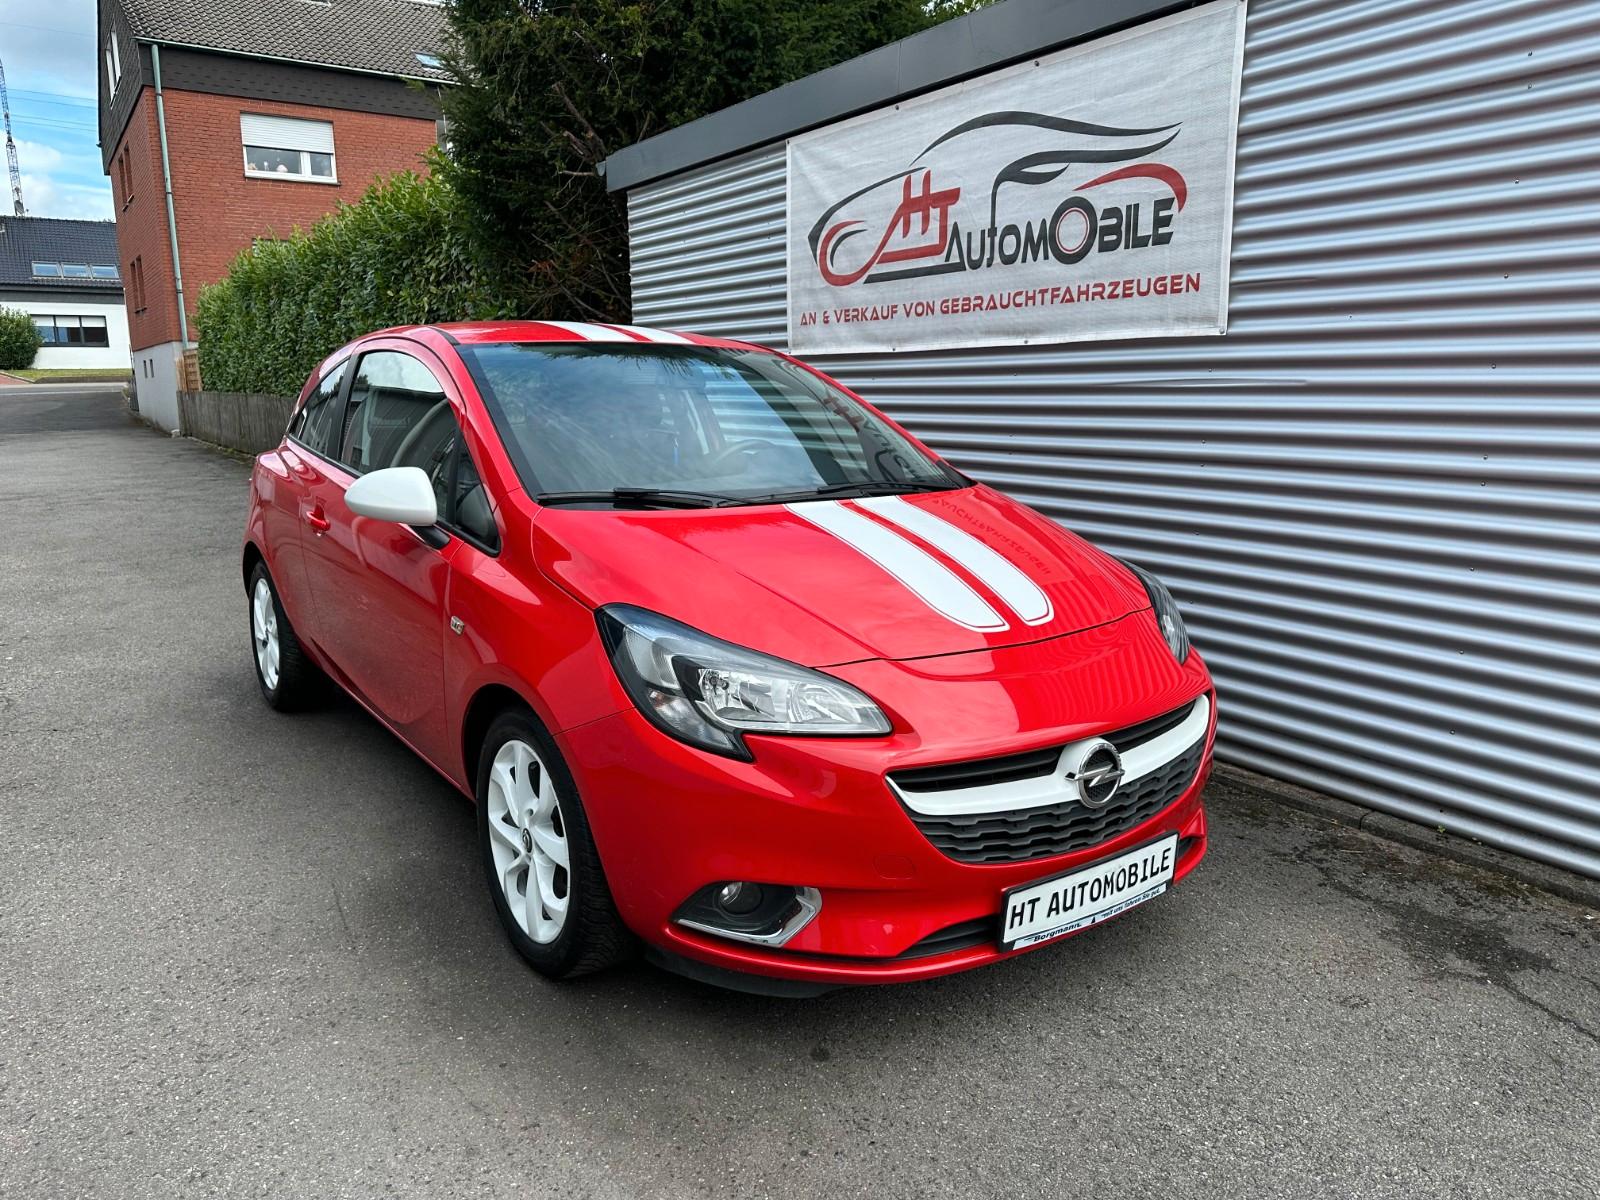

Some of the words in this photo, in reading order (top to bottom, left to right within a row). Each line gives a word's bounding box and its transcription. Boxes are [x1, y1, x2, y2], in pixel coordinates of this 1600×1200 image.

[800, 312, 817, 326] AN
[822, 310, 830, 325] &
[834, 304, 898, 323] VERKAUF
[903, 301, 935, 318] VON
[940, 273, 1200, 315] GEBRAUCHTFAHRZEUGEN
[1009, 897, 1040, 929] HT
[1047, 848, 1171, 917] AUTOMOBILE
